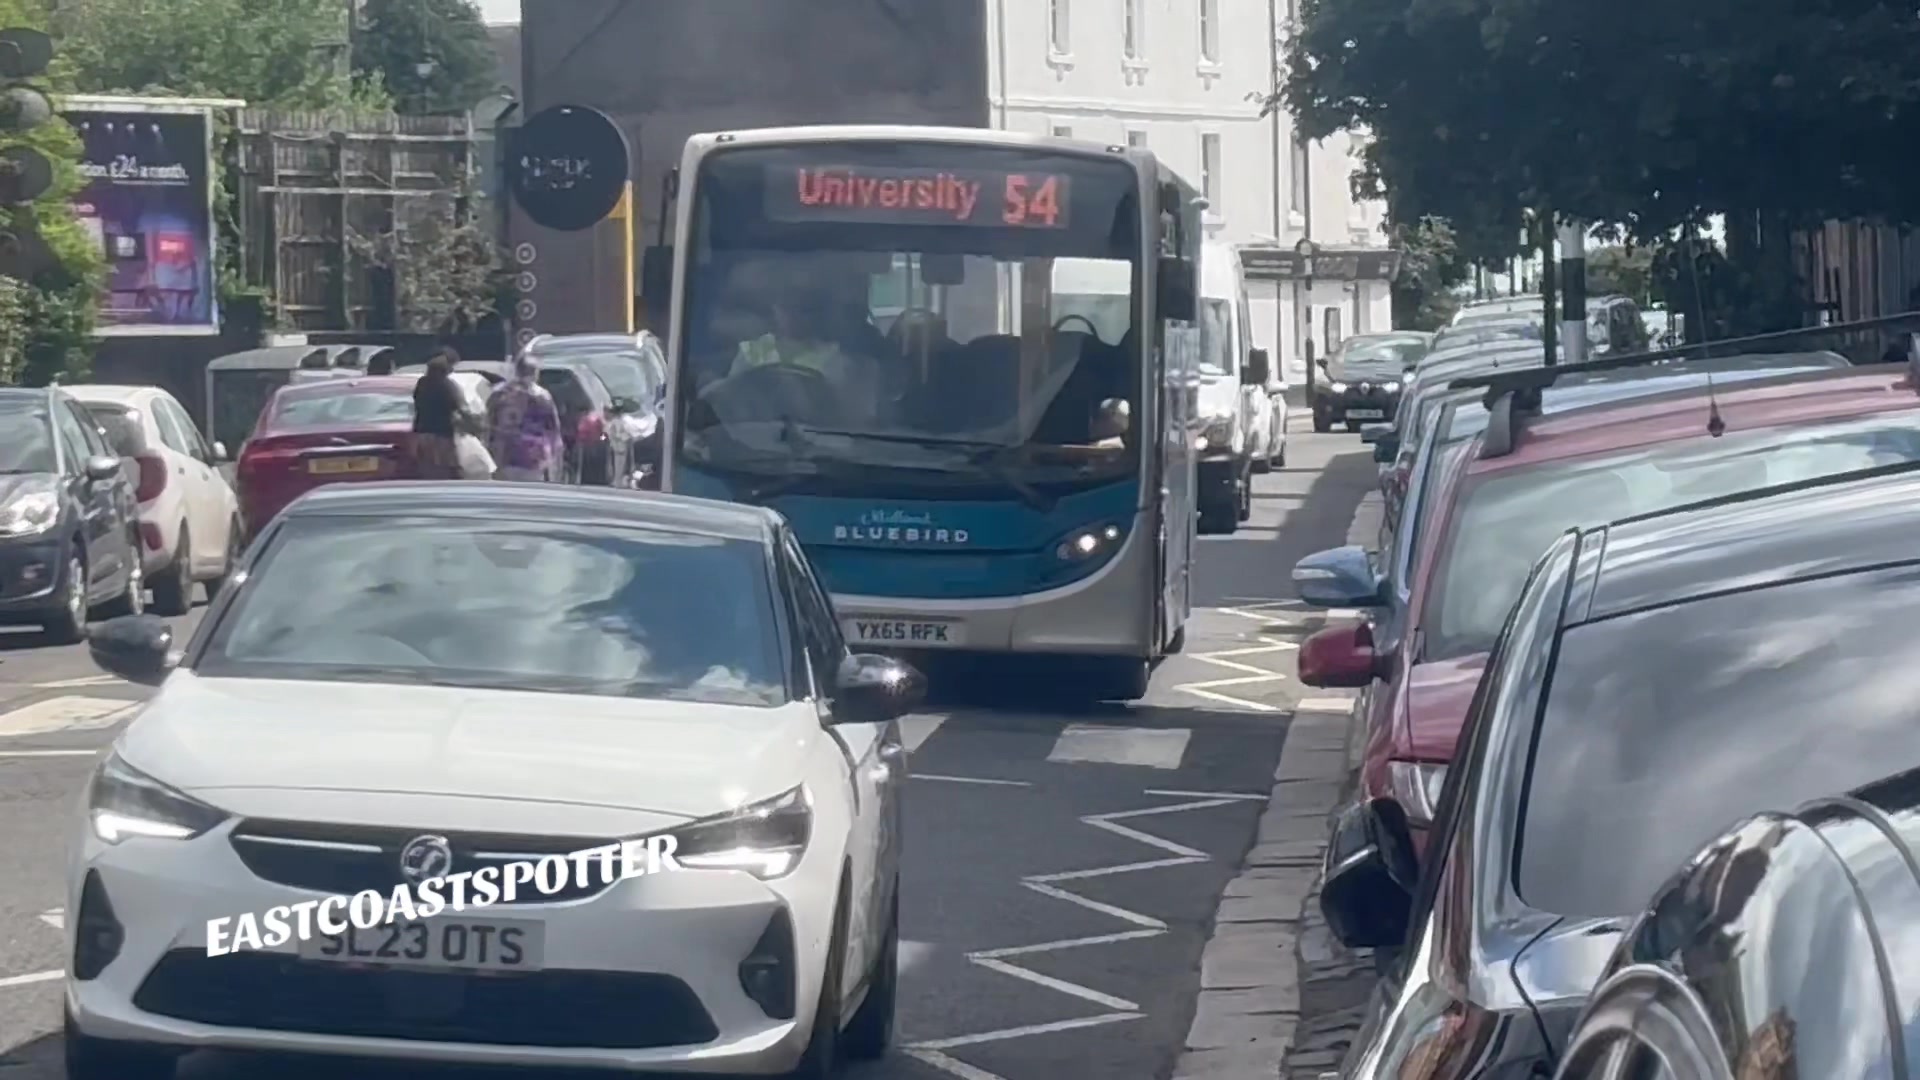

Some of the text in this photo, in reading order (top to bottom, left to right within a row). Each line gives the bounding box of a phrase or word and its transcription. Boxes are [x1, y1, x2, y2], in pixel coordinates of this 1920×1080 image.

[797, 168, 1060, 224] University 54
[834, 525, 968, 543] BLUEBIRD
[856, 621, 949, 641] YX65 RFK
[442, 924, 524, 964] OTS
